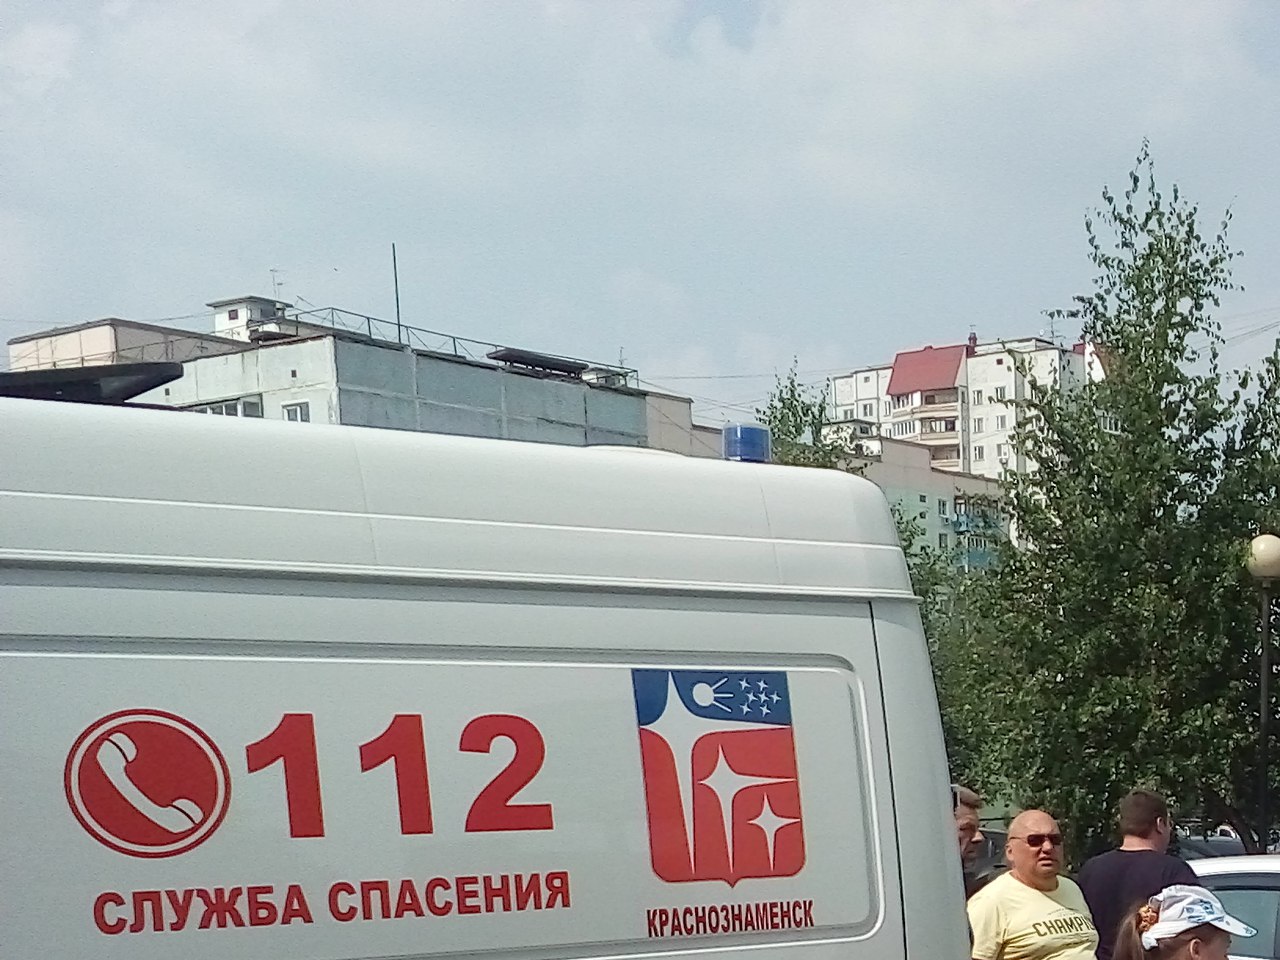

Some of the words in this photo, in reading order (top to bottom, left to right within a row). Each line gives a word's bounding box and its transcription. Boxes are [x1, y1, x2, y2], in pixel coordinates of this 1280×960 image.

[246, 713, 554, 838] 112
[93, 884, 314, 936] СЛУЖБА
[327, 870, 573, 923] СПАСЕНИЯ
[646, 899, 815, 938] КРАСНОЗНАМЕНСК
